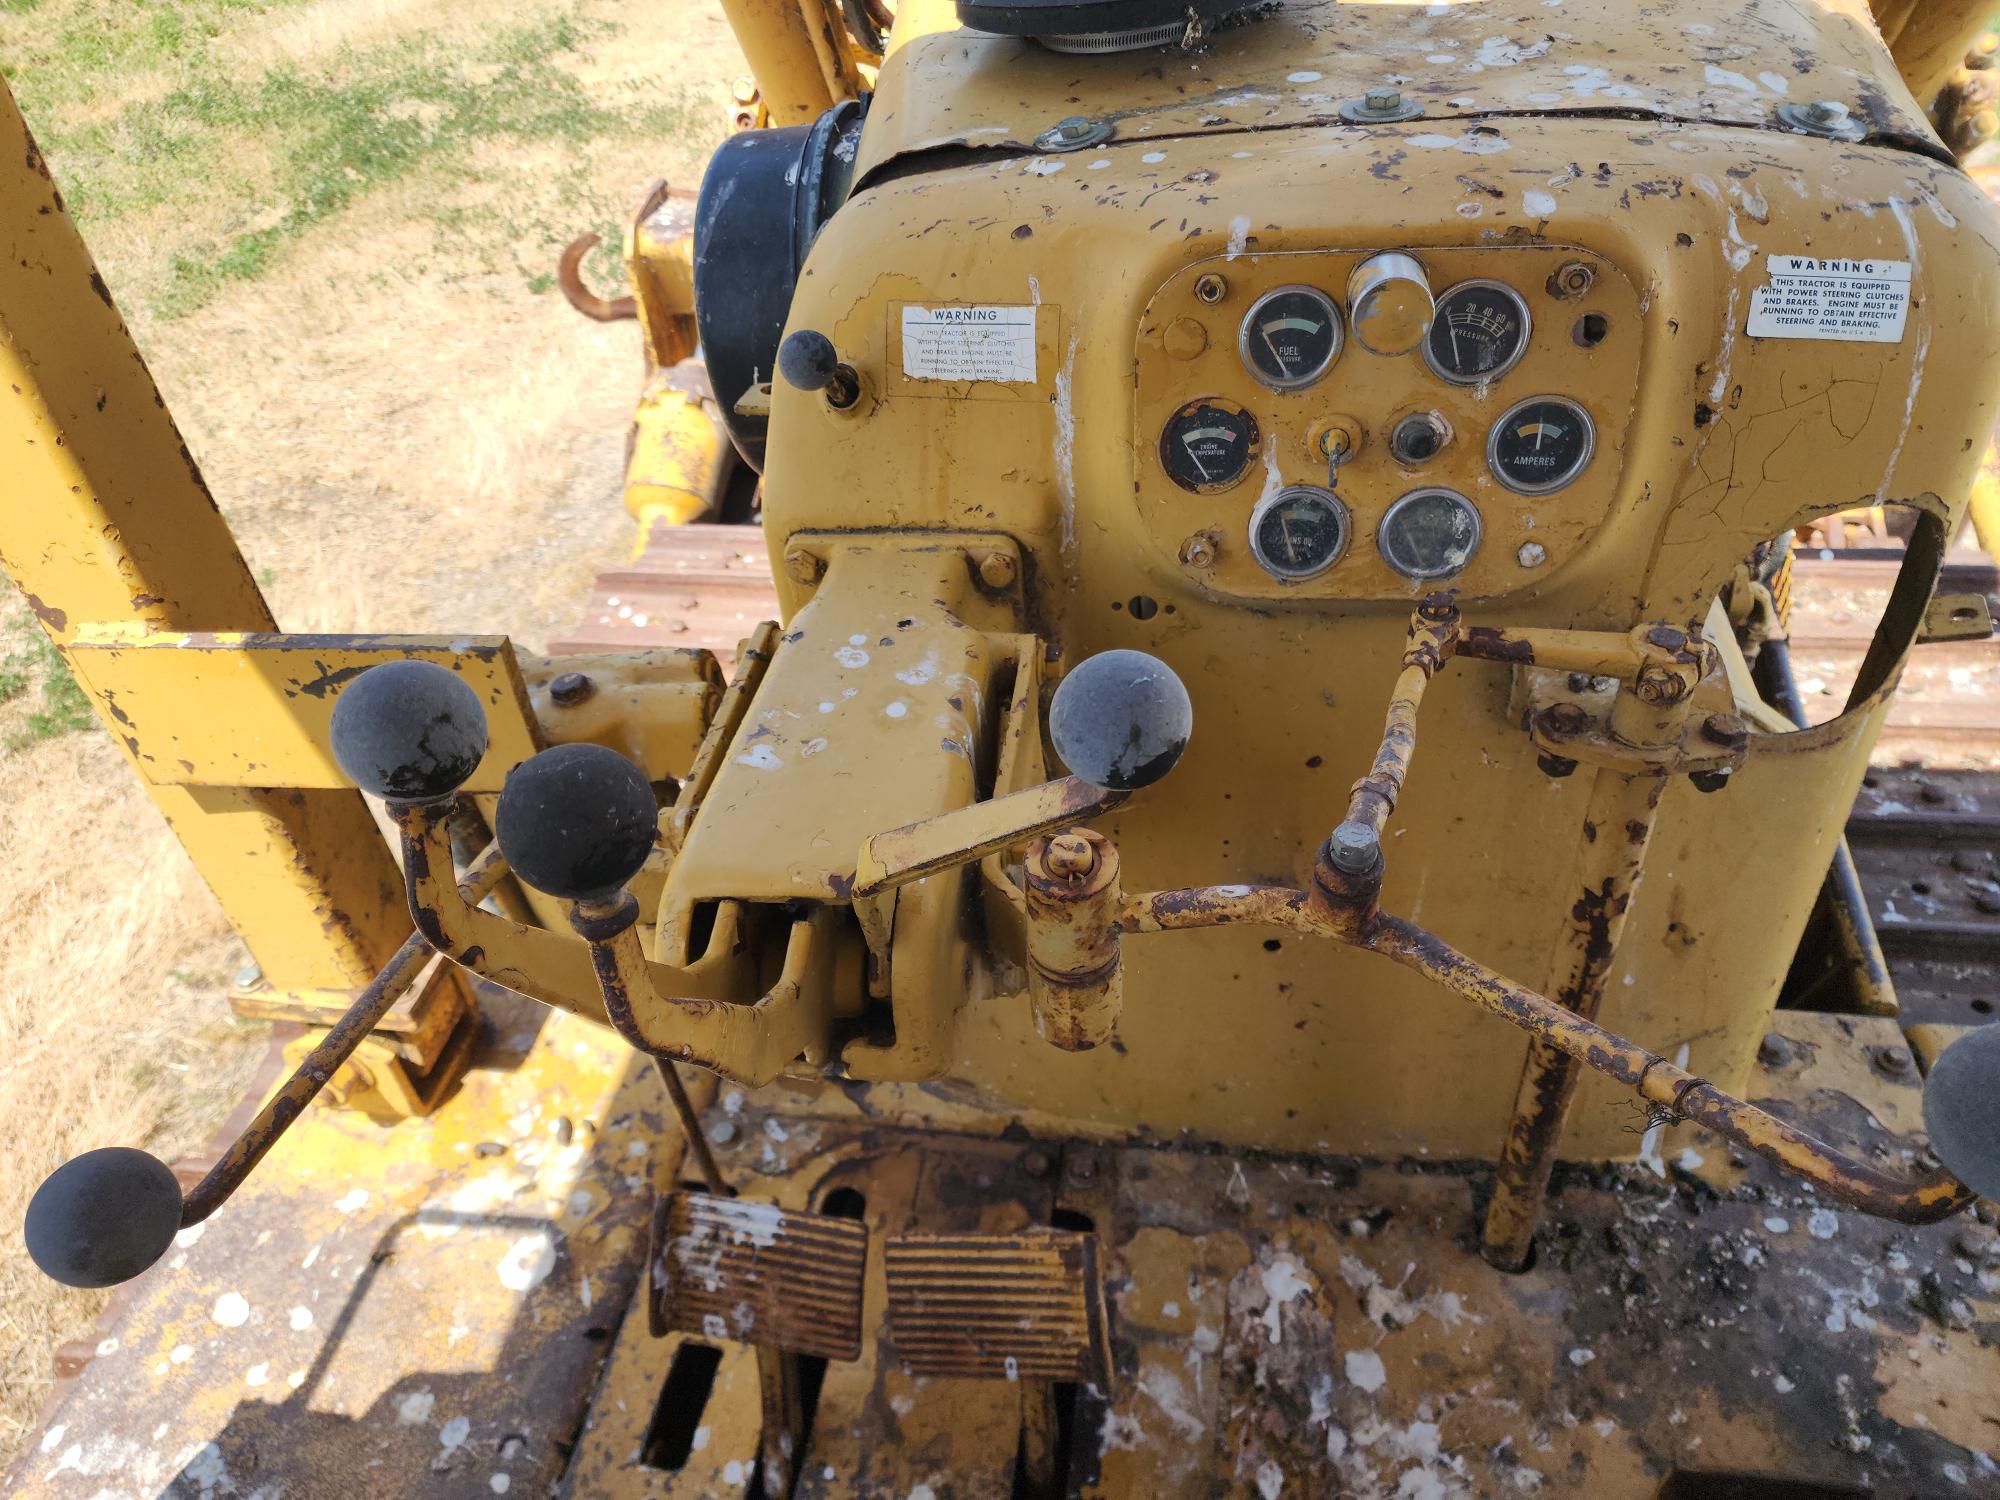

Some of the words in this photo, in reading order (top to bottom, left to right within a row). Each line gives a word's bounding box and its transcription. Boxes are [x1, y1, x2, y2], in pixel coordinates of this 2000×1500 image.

[1790, 259, 1874, 274] WARNING
[1776, 278, 1794, 287] THIS
[1798, 279, 1835, 288] TRACTOR
[1839, 281, 1847, 289] IS
[1851, 282, 1891, 291] EQUIPPED
[1760, 287, 1782, 296] WITH
[1787, 288, 1818, 297] POWER
[1822, 290, 1861, 299] STEERING
[1865, 292, 1904, 301] CLUTCHES
[1466, 302, 1477, 313] 20
[1763, 297, 1782, 305] AND
[1785, 298, 1819, 307] BRAKES.
[1828, 300, 1859, 308] ENGINE
[1863, 301, 1885, 310] MUST
[1889, 302, 1899, 310] BE
[934, 310, 997, 320] WARNING
[1482, 306, 1493, 317] 40
[1763, 307, 1803, 315] RUNNING
[1808, 308, 1819, 316] TO
[1823, 309, 1855, 318] OBTAIN
[1859, 310, 1897, 320] EFFECTIVE
[1495, 313, 1507, 324] 60
[1776, 317, 1815, 325] STEERING
[1818, 318, 1838, 327] AND
[1841, 319, 1880, 329] BRAKING.
[1279, 346, 1299, 356] FUEL
[1513, 456, 1556, 467] AMPERES
